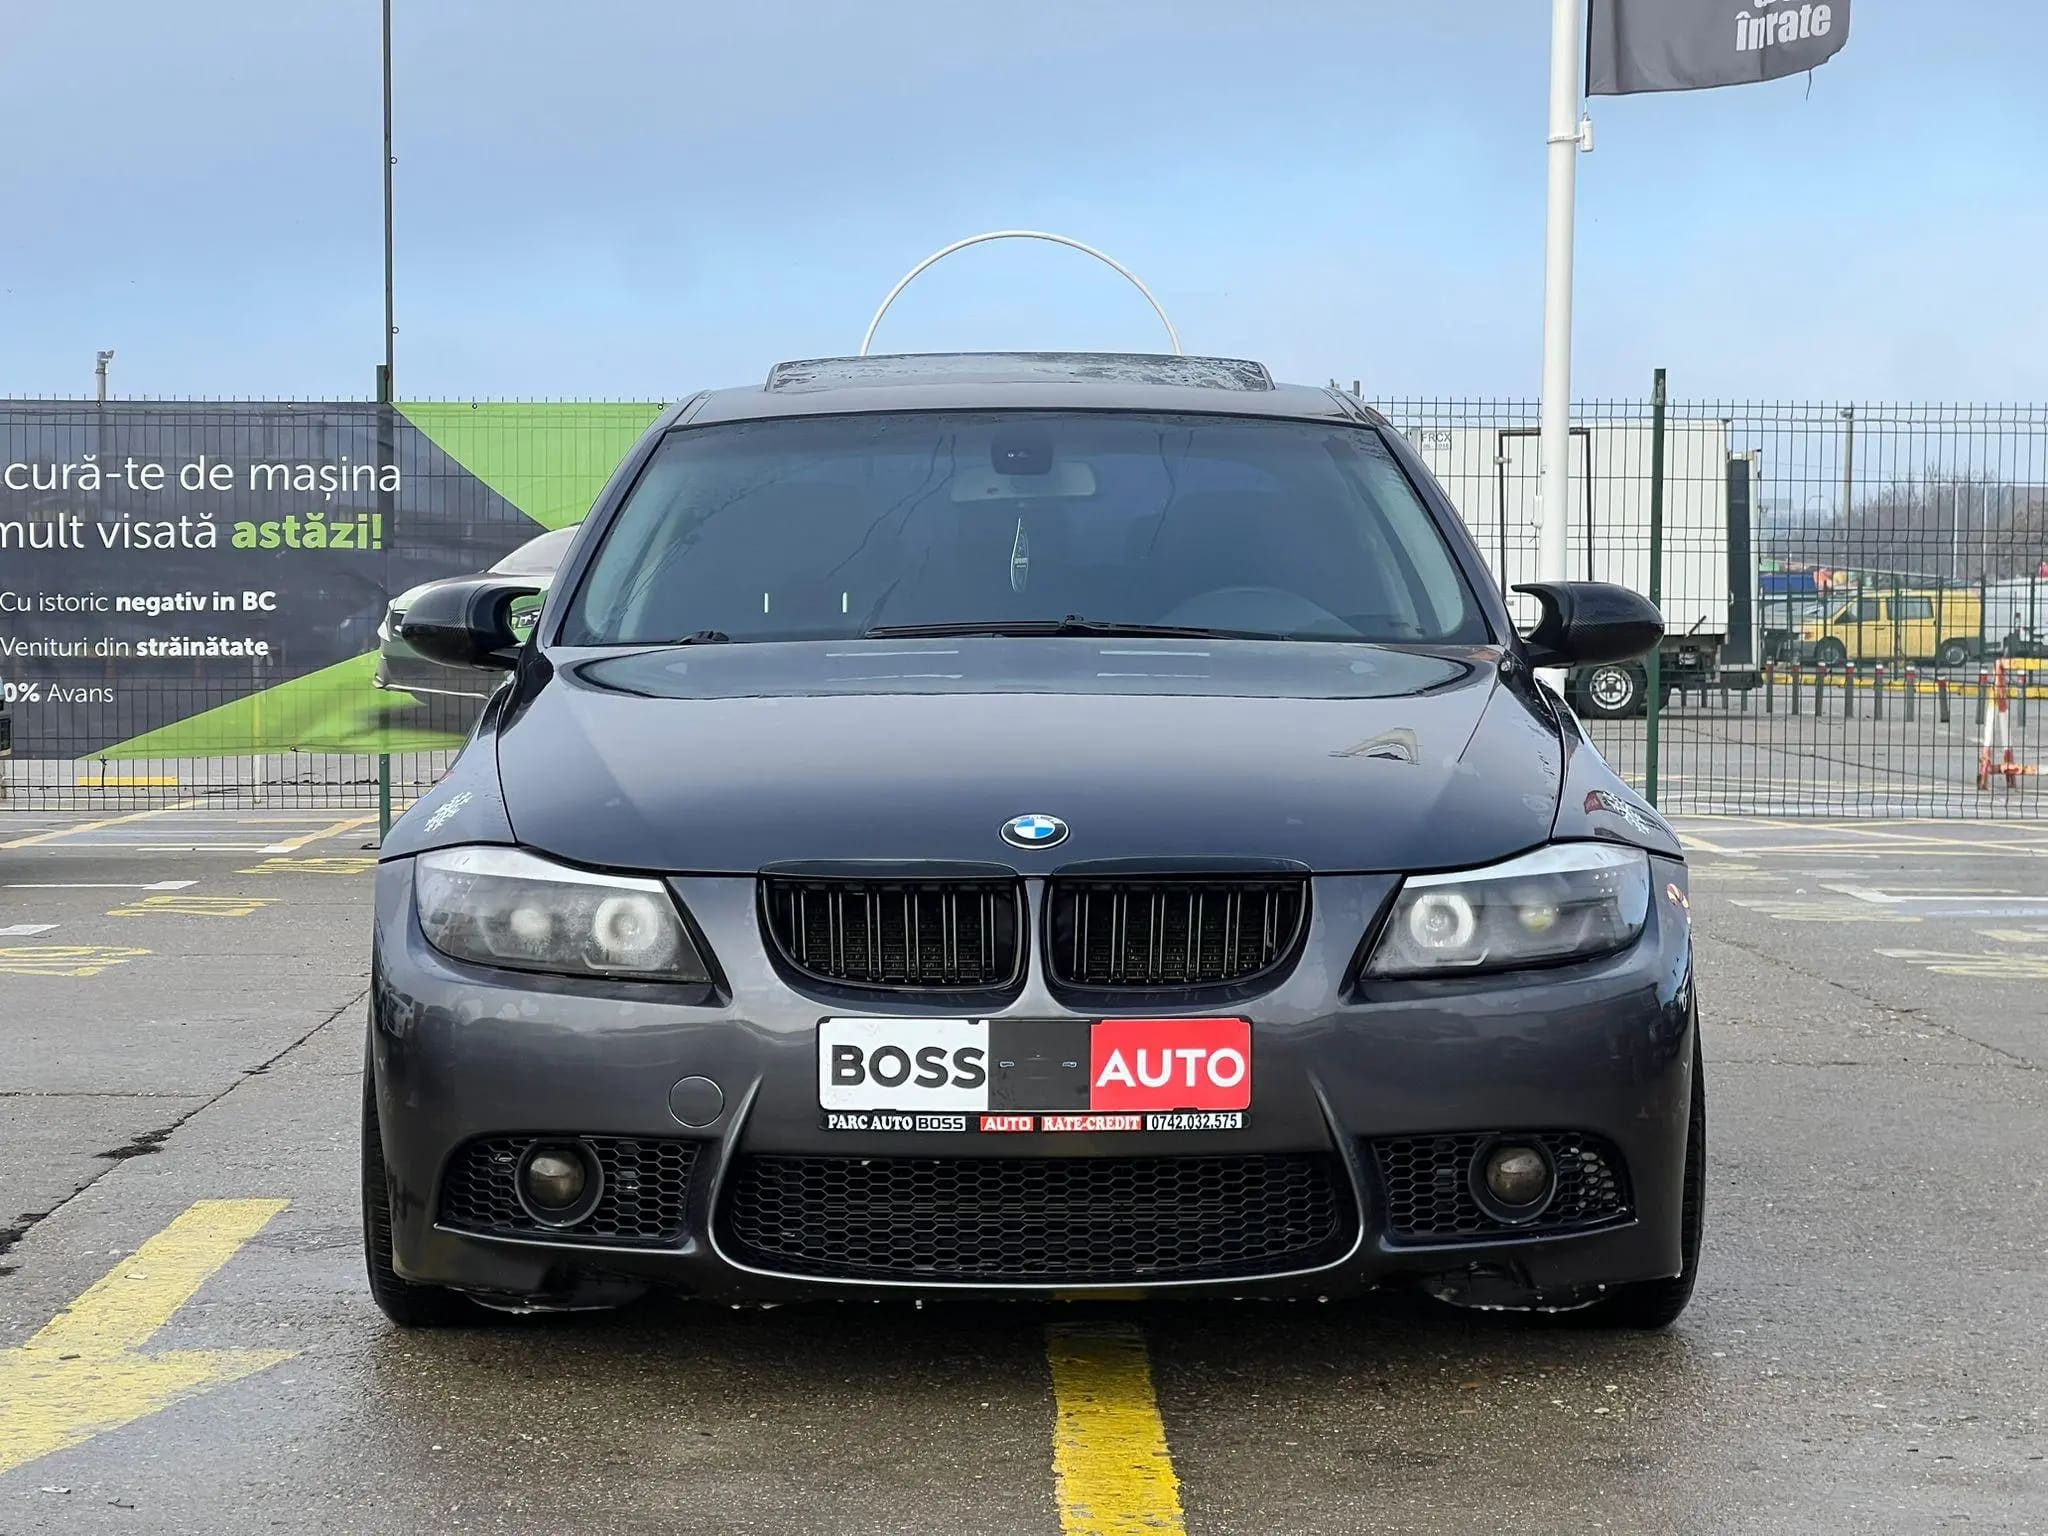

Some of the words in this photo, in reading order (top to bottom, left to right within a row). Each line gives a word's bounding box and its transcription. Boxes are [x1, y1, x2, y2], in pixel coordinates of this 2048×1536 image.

[179, 455, 234, 491] de
[249, 456, 402, 500] mașina
[0, 513, 84, 550] mult
[96, 512, 218, 550] visată
[231, 512, 383, 550] astăzi!
[0, 591, 31, 612] Cu
[39, 591, 109, 612] istoric
[115, 592, 207, 616] negativ
[212, 592, 236, 612] in
[242, 591, 277, 612] BC
[0, 636, 88, 657] Venituri
[94, 637, 129, 657] din
[136, 636, 269, 657] străinătate
[3, 682, 40, 703] 0%
[47, 683, 114, 703] Avans
[831, 1044, 986, 1090] BOSS
[1096, 1047, 1246, 1088] AUTO
[828, 1114, 869, 1130] PARC
[870, 1115, 914, 1130] AUTO
[918, 1116, 965, 1130] BOSS
[983, 1116, 1031, 1131] AUTO
[1151, 1114, 1238, 1130] 0742.032.575
